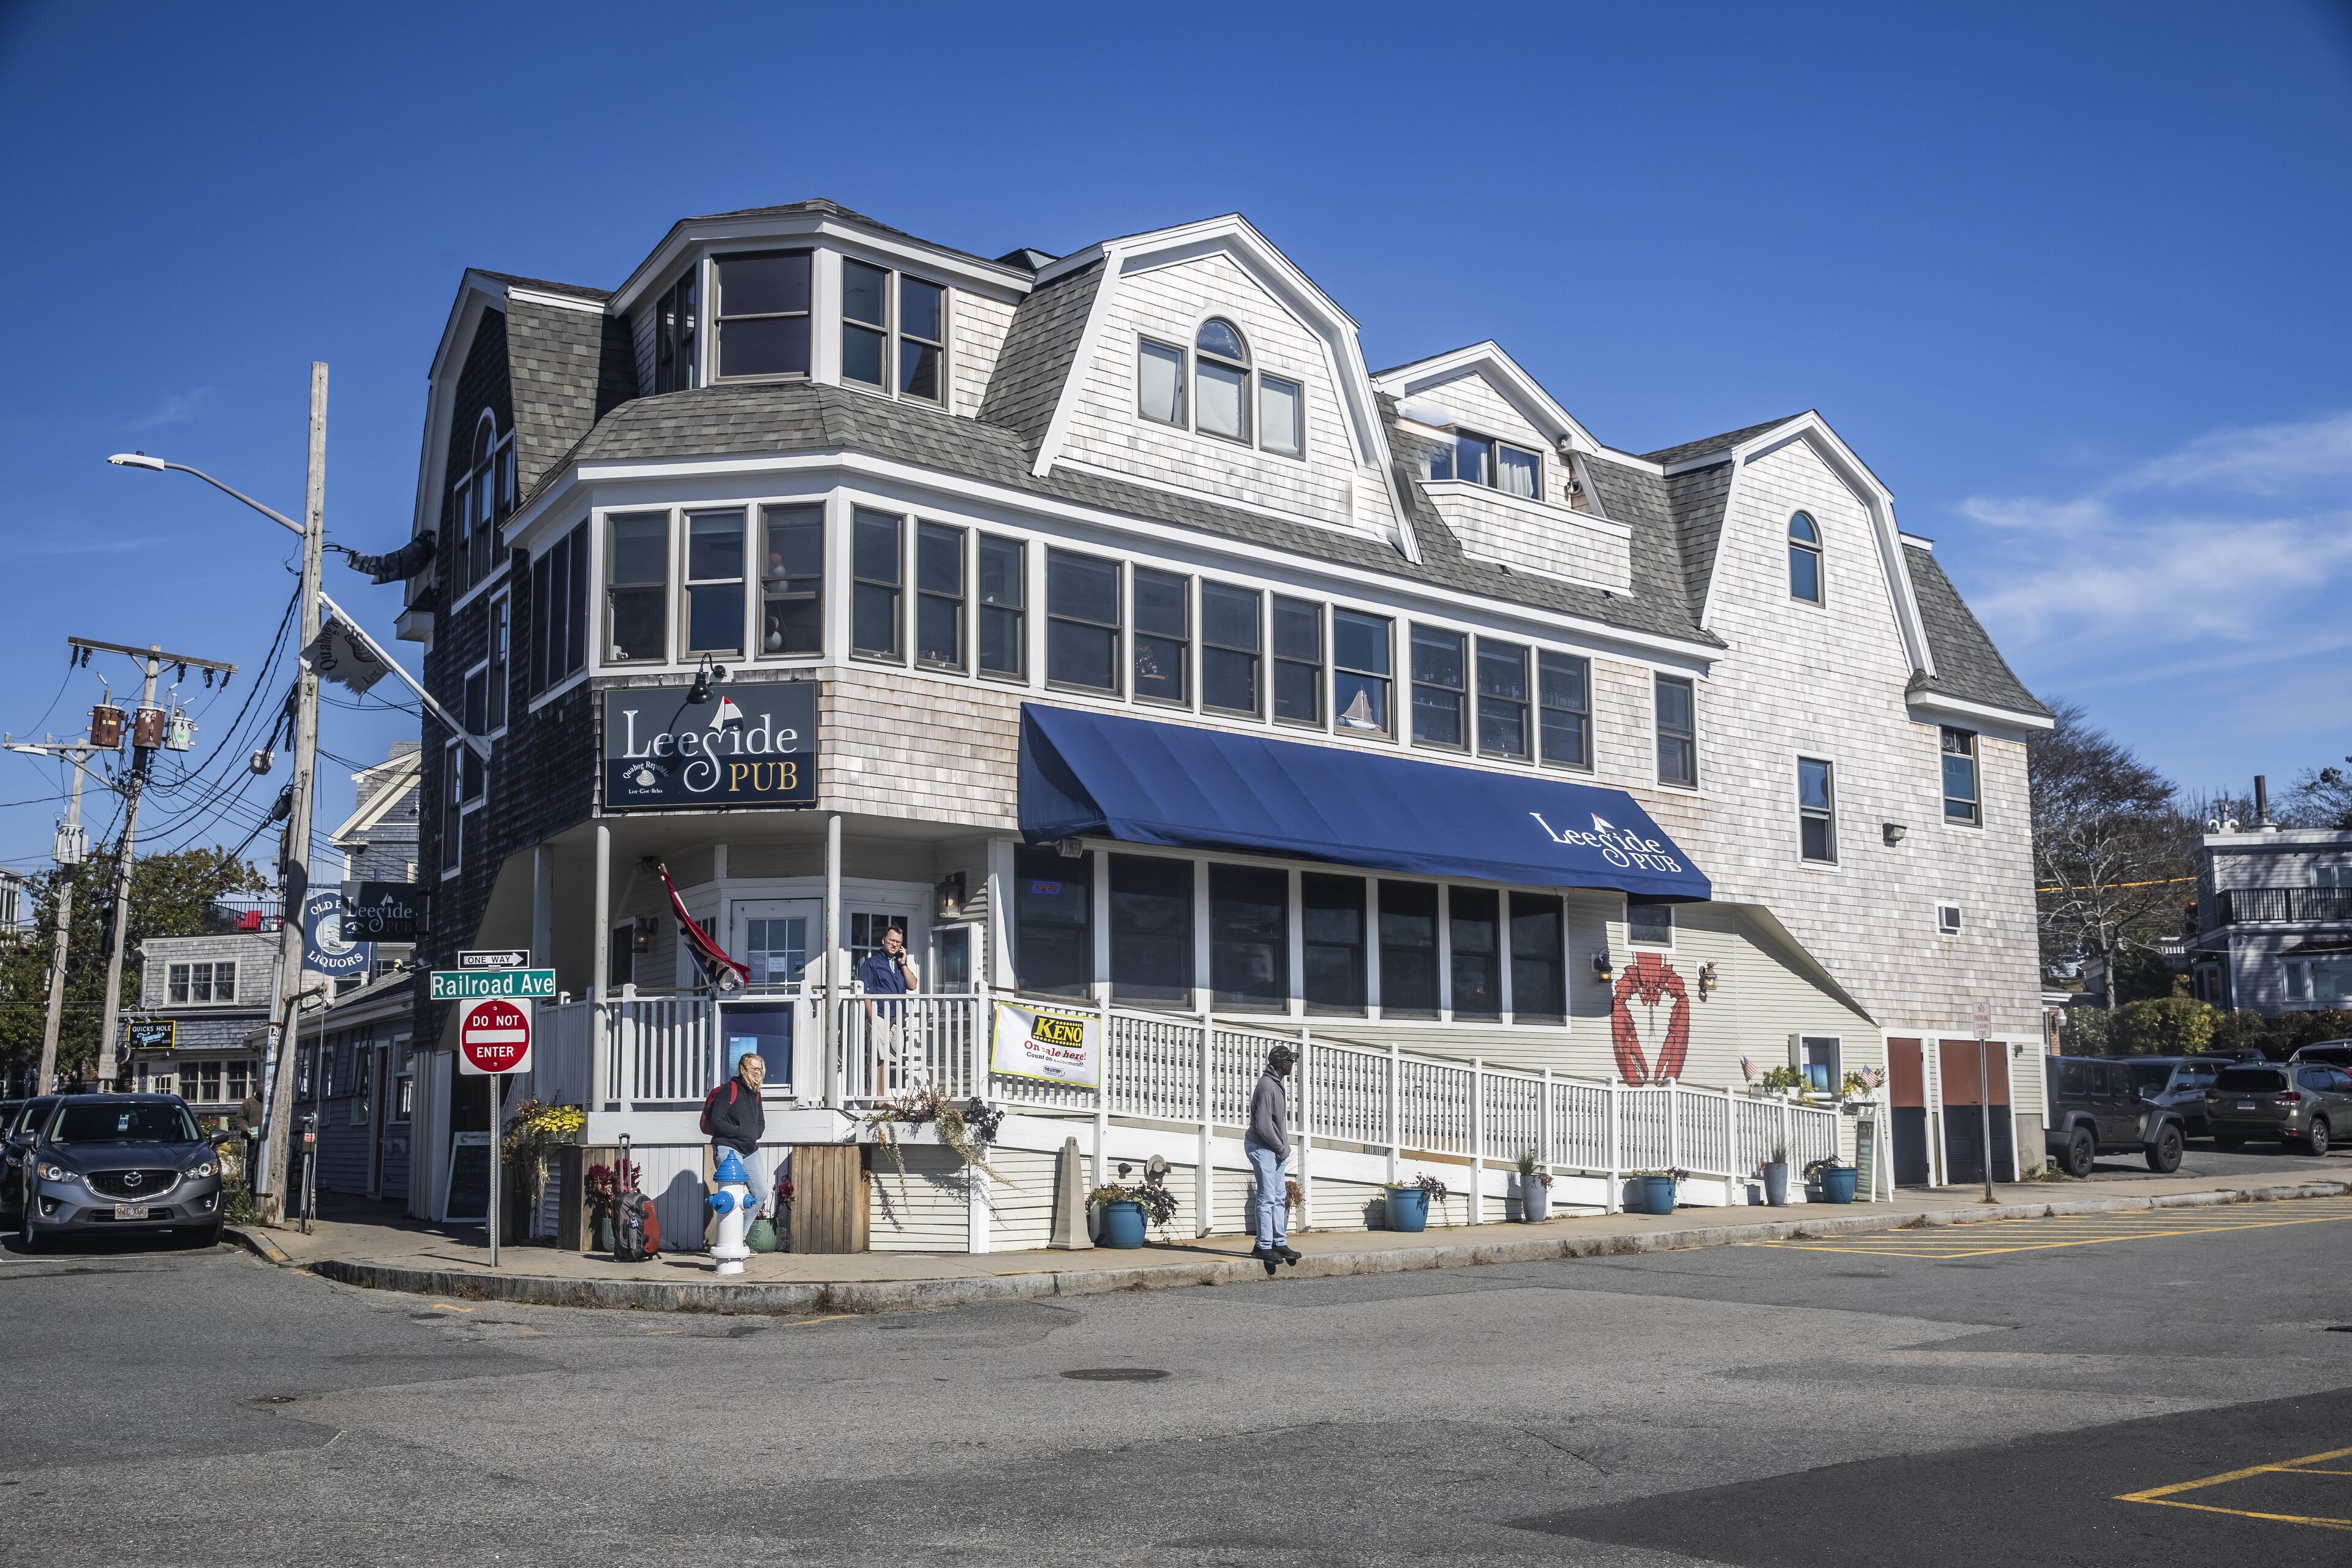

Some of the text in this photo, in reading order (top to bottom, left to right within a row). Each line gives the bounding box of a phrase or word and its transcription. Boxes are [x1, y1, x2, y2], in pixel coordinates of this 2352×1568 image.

[623, 761, 668, 778] Quahog Republic
[729, 762, 797, 791] PUB
[1628, 852, 1682, 872] PUB
[311, 901, 333, 915] OLD
[386, 922, 412, 933] PUB
[307, 951, 363, 968] LIQUORS
[432, 974, 553, 995] Railroad Ave
[473, 1015, 519, 1027] DO NOT
[1034, 1017, 1083, 1042] KENO
[477, 1047, 514, 1058] ENTER
[1024, 1041, 1040, 1051] On
[1062, 1050, 1087, 1060] here!
